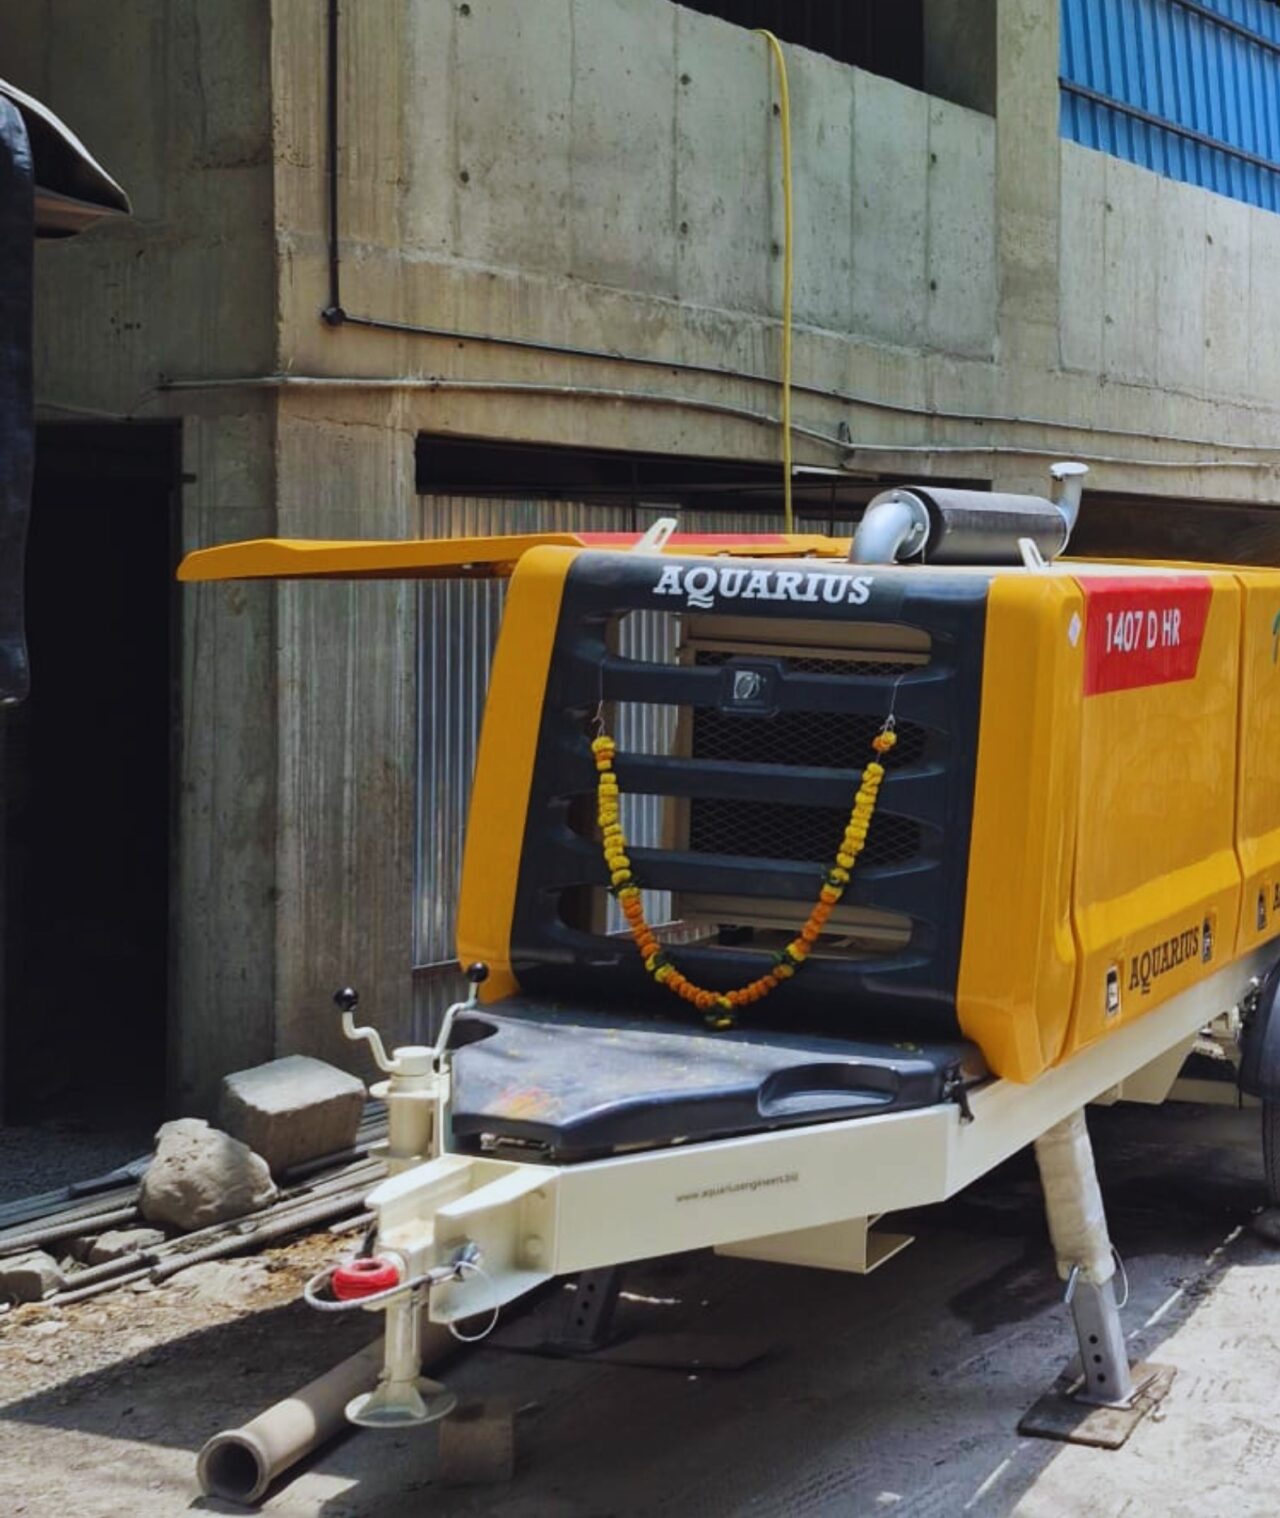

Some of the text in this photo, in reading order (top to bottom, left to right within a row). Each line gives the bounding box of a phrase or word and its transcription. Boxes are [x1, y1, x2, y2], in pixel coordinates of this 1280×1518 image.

[653, 565, 874, 609] AQUARIUS
[1105, 608, 1182, 654] 1407 D HR
[1129, 927, 1199, 994] AQUARIUS
